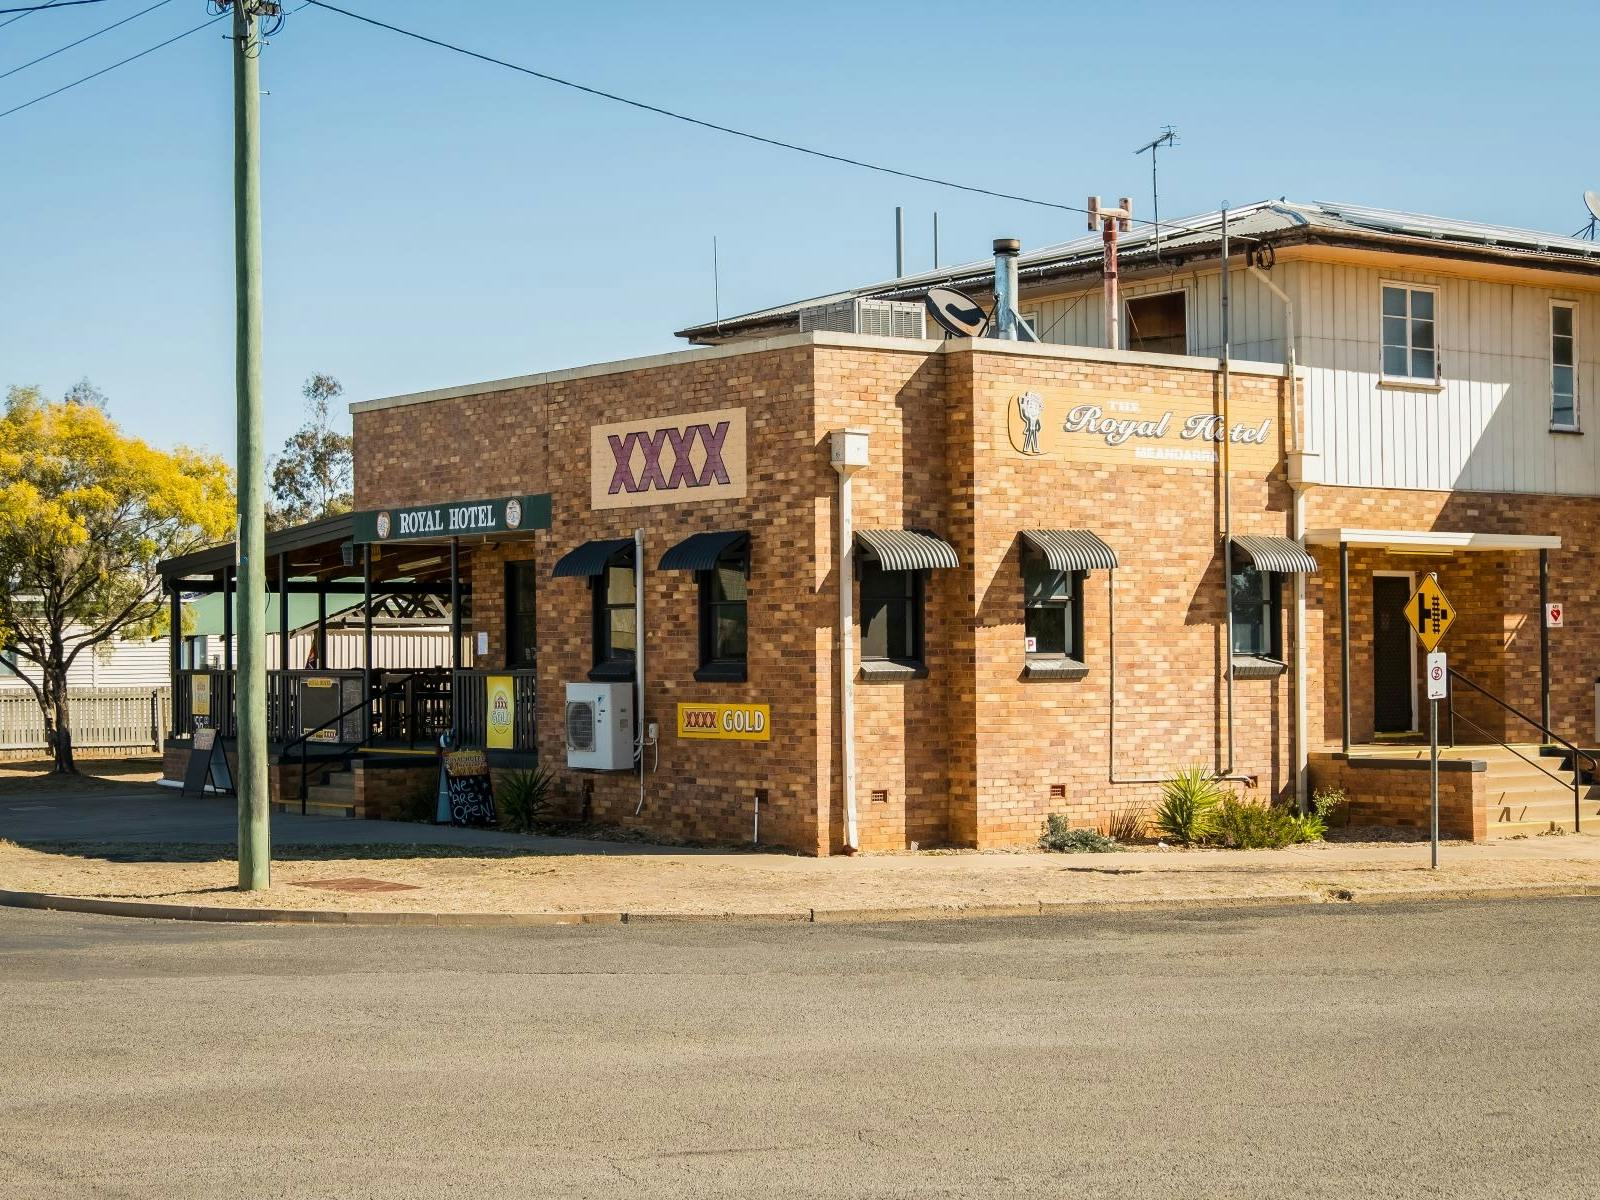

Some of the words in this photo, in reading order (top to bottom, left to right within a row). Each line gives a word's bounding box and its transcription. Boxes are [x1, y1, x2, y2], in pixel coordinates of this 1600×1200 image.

[1064, 405, 1173, 445] Royal
[1180, 414, 1272, 444] Hotel
[607, 421, 731, 495] XXXX
[400, 509, 444, 534] ROYAL
[449, 505, 496, 530] HOTEL
[685, 711, 717, 728] XXXX
[722, 710, 765, 733] GOLD
